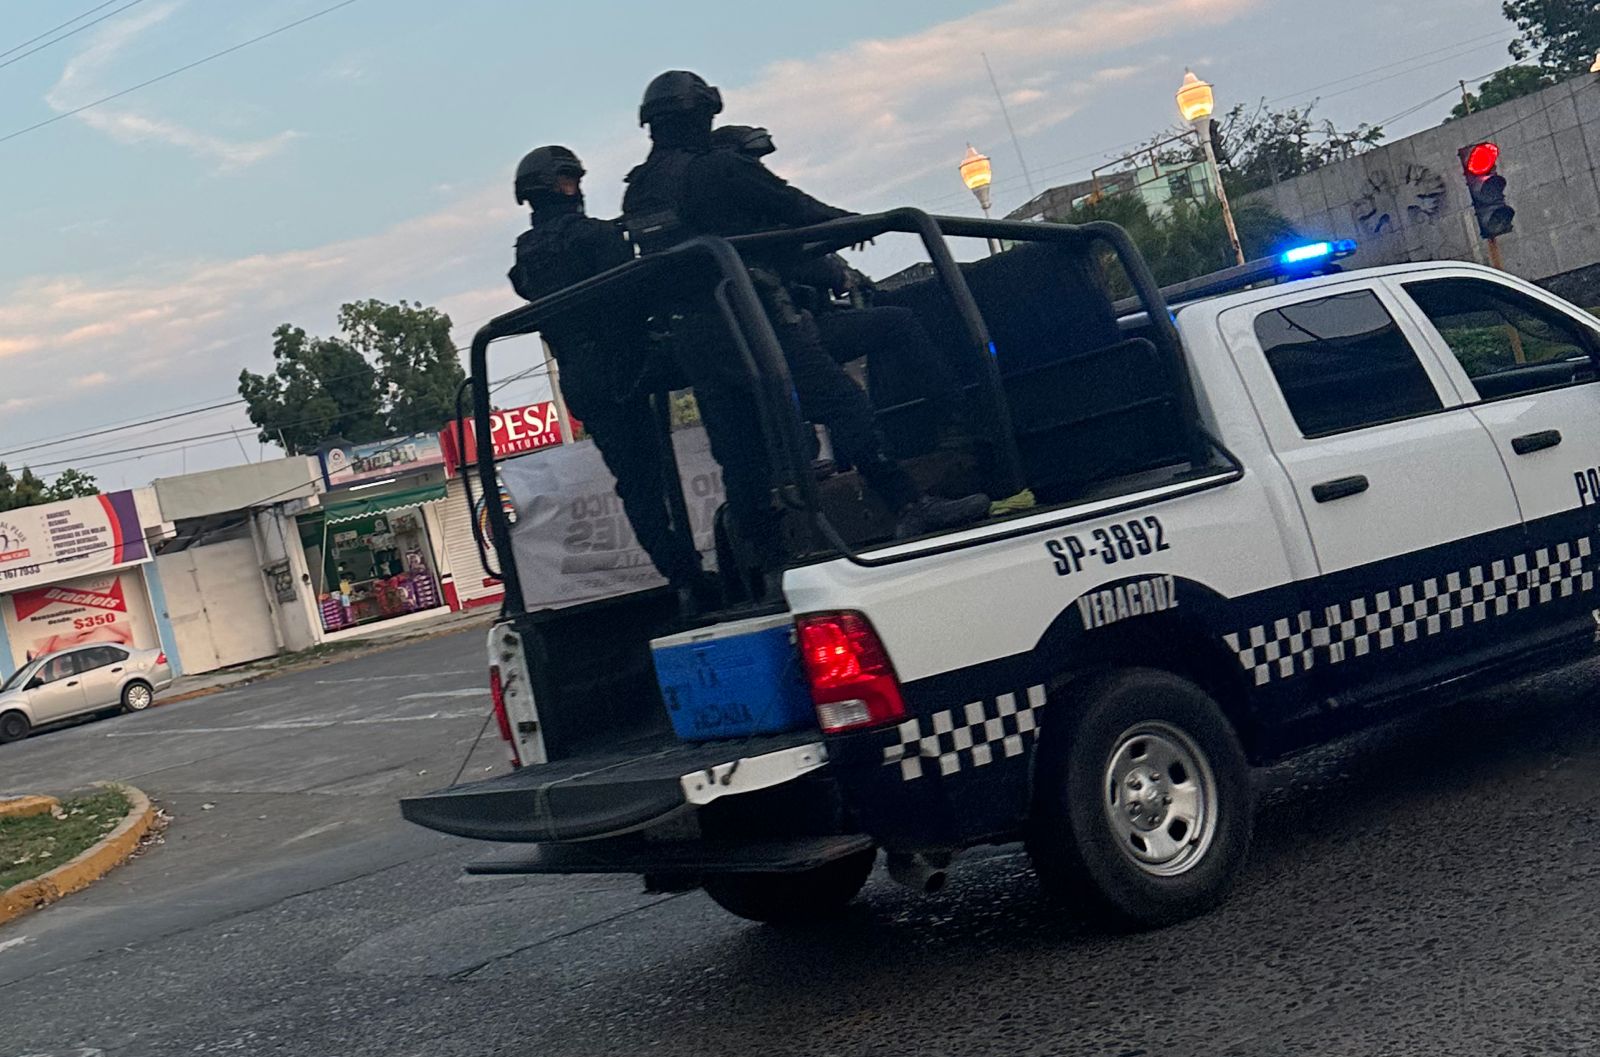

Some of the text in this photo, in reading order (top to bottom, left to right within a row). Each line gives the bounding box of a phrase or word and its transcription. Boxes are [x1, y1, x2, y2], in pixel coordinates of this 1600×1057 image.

[493, 433, 556, 455] PINTURAS
[1574, 466, 1600, 507] PO
[1045, 516, 1170, 576] SP-3892
[44, 588, 120, 608] Brackets
[1077, 574, 1179, 630] VERACRUZ
[73, 613, 116, 630] $350
